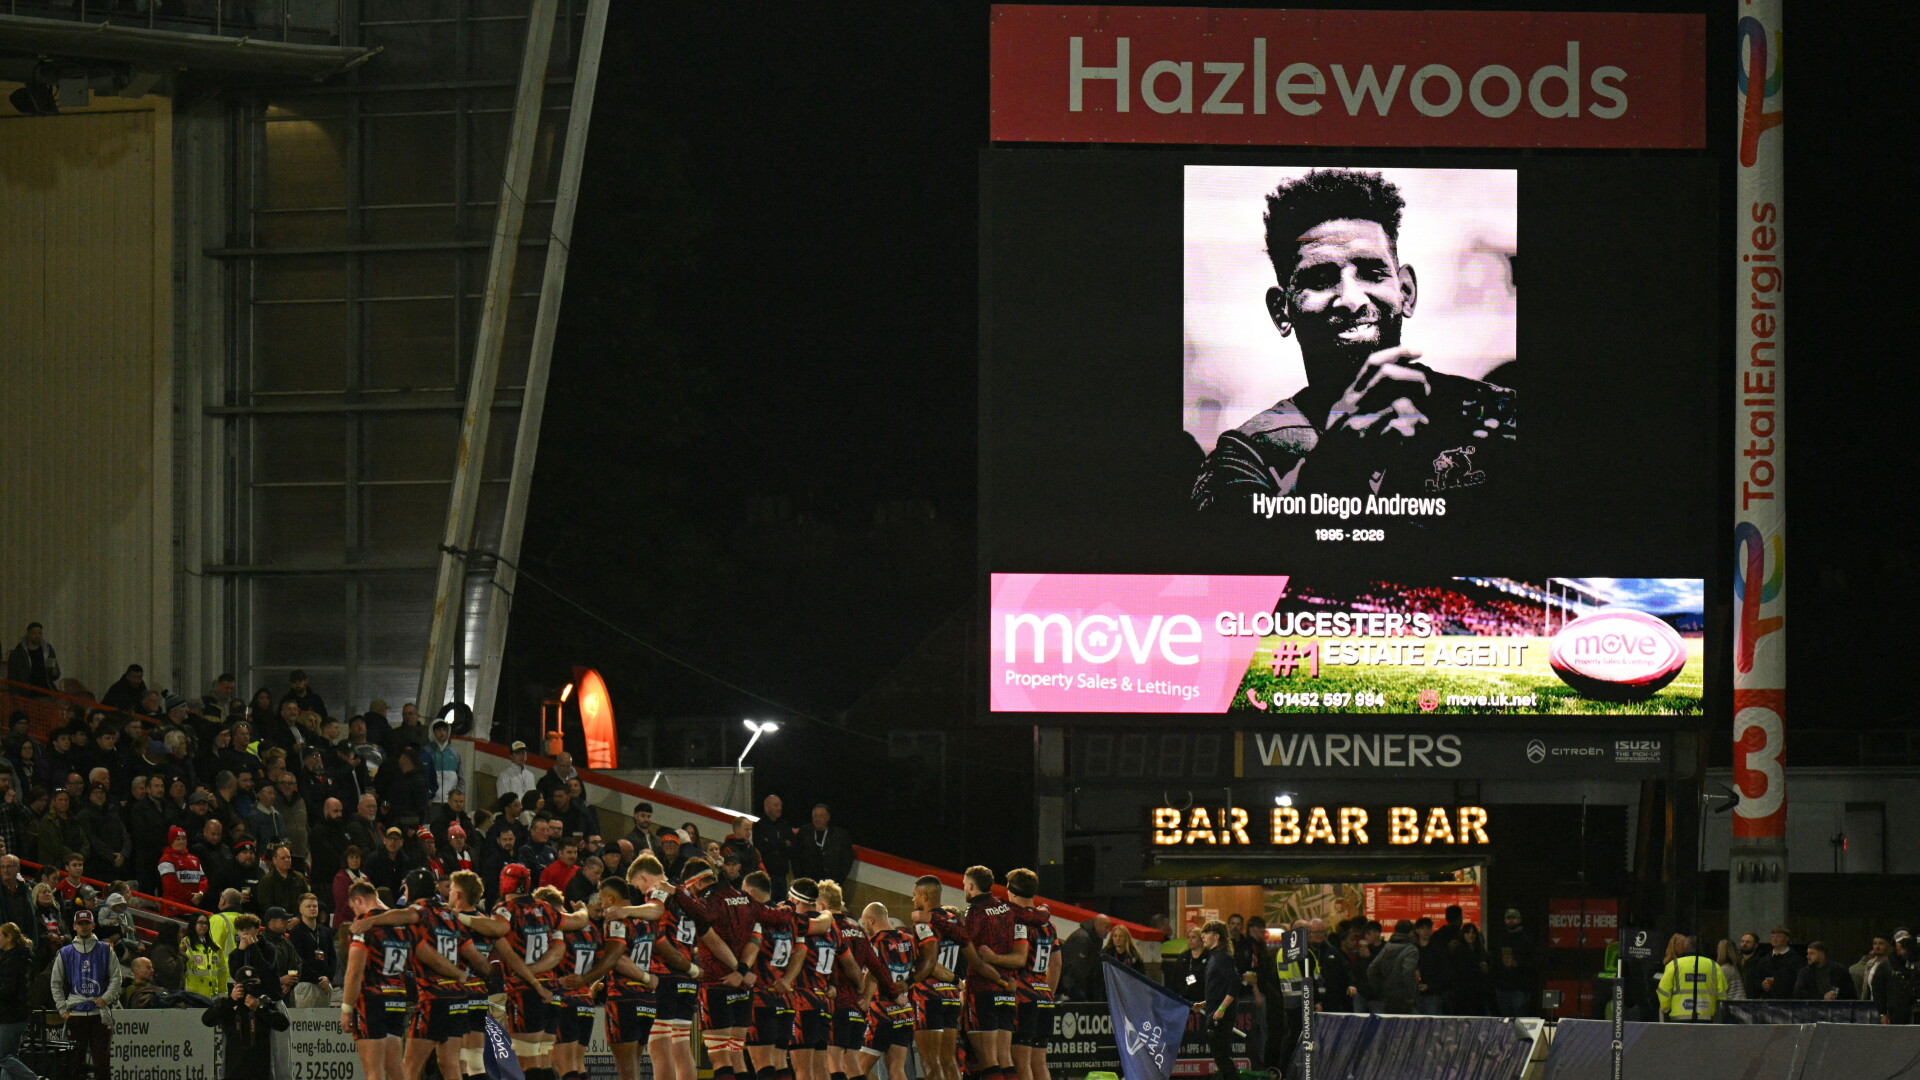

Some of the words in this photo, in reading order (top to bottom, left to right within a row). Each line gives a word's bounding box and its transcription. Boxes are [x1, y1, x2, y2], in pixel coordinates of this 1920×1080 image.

[1069, 36, 1628, 120] Hazlewoods
[1741, 202, 1783, 511] TotalEnergies
[1252, 493, 1306, 519] Hyron
[1310, 493, 1362, 520] Diego
[1365, 492, 1446, 517] Andrews
[1315, 529, 1344, 541] 1995
[1352, 529, 1385, 541] 2026
[1215, 611, 1431, 637] GLOUCESTER'S
[1004, 613, 1203, 666] move
[1574, 633, 1657, 656] move
[1270, 640, 1319, 678] #1
[1323, 640, 1425, 666] ESTATE
[1432, 642, 1528, 667] AGENT
[1005, 670, 1073, 691] Property
[1077, 673, 1117, 690] Sales
[1121, 677, 1133, 692] &
[1137, 678, 1200, 701] Lettings
[1273, 692, 1319, 707] 01452
[1323, 692, 1351, 707] 597
[1355, 693, 1385, 708] 994
[1446, 692, 1537, 708] move.uk.net
[1255, 733, 1462, 768] WARNERS
[1614, 740, 1661, 750] ISUZU
[1733, 706, 1785, 819] 3
[1151, 806, 1250, 846] BAR
[1269, 806, 1369, 846] BAR
[1388, 806, 1490, 846] BAR
[1263, 877, 1277, 886] PAY
[1278, 877, 1287, 885] BY
[1288, 877, 1309, 885] CARD
[1366, 887, 1375, 912] MENU
[1593, 914, 1618, 928] HERE
[388, 949, 402, 974] 2
[440, 937, 456, 967] 12
[532, 935, 543, 963] 8
[634, 943, 649, 968] 14
[1038, 945, 1048, 971] 6
[581, 951, 591, 975] 7
[292, 1019, 343, 1034] renew-eng
[109, 1040, 180, 1061] Engineering
[183, 1039, 193, 1057] &
[291, 1042, 358, 1057] -eng-fab.co.u
[592, 1039, 598, 1053] &
[1046, 1041, 1097, 1054] BARBERS
[1187, 1043, 1200, 1054] APPS
[186, 1064, 208, 1080] Ltd.
[306, 1061, 354, 1080] 525609
